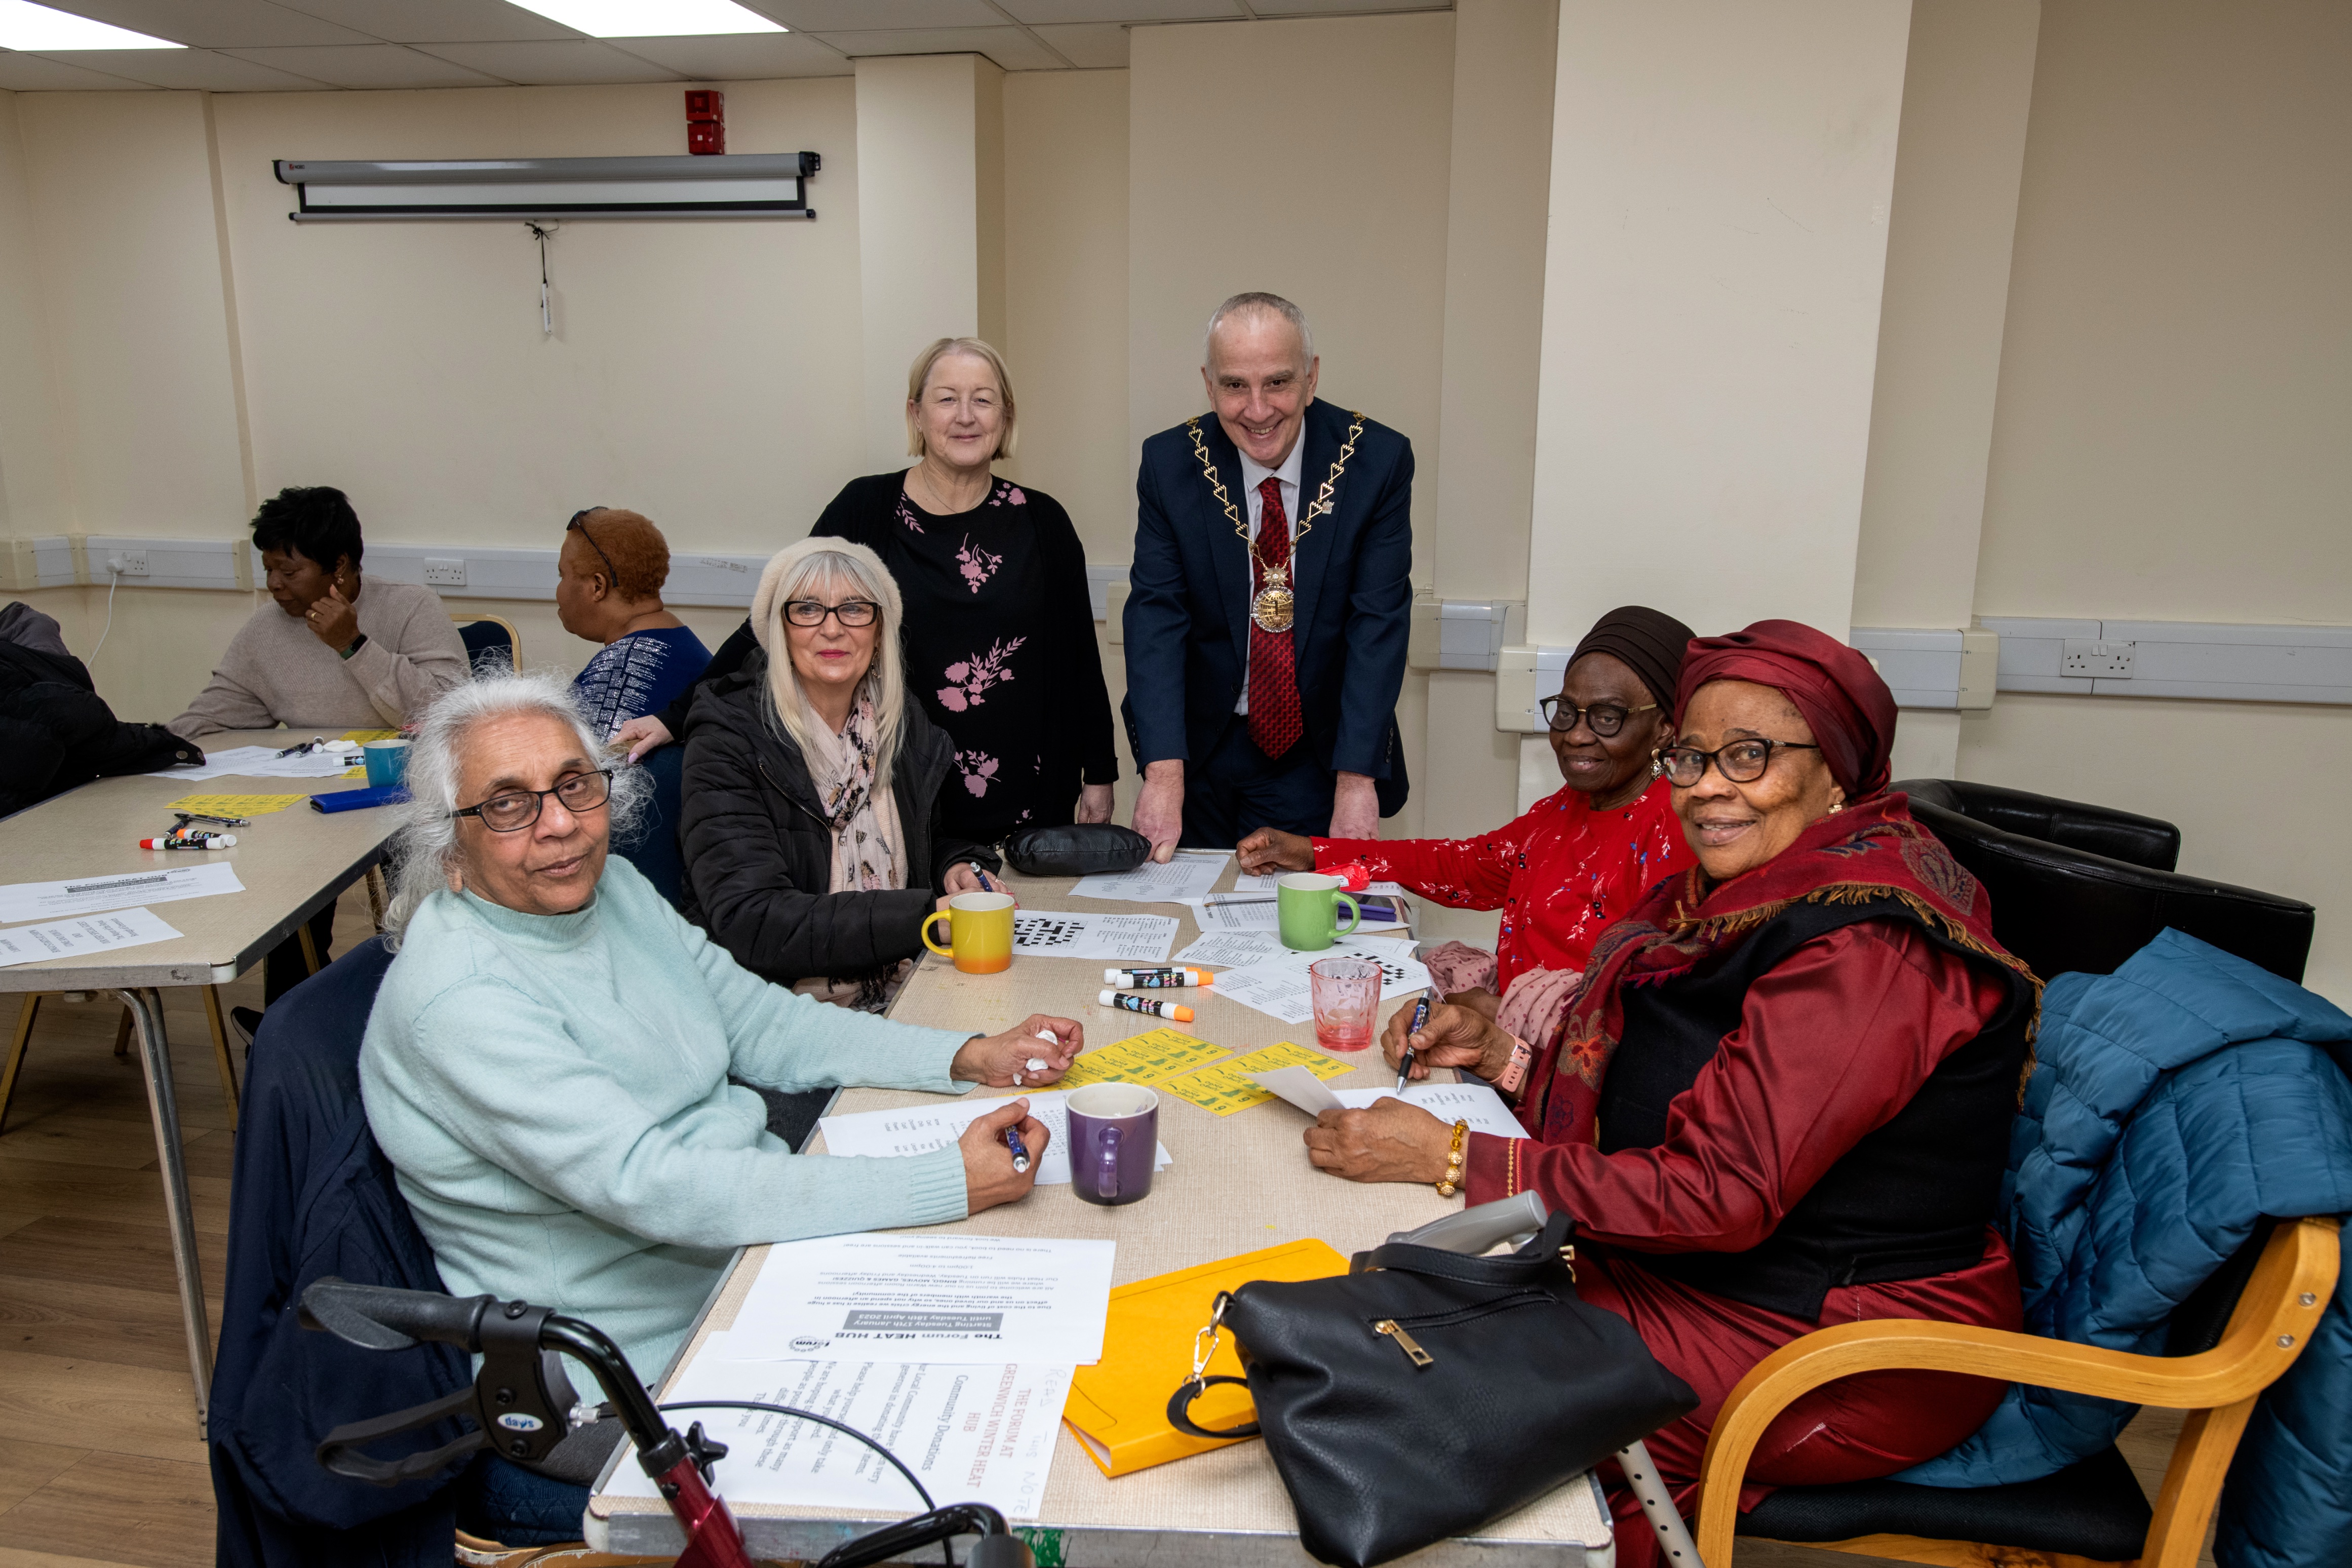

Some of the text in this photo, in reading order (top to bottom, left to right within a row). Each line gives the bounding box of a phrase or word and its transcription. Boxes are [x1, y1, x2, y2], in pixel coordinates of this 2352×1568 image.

[802, 1361, 819, 1382] people
[819, 1370, 830, 1381] are
[856, 1361, 874, 1382] Please
[918, 1363, 927, 1372] ur
[891, 1364, 910, 1393] generous
[910, 1373, 925, 1389] Local
[804, 1382, 827, 1404] hoping
[827, 1389, 841, 1405] what
[846, 1382, 864, 1397] help
[872, 1402, 895, 1432] donating
[891, 1390, 917, 1429] Community
[737, 1414, 751, 1427] you
[755, 1414, 773, 1434] times.
[921, 1375, 968, 1471] Community Donations
[963, 1413, 981, 1432] HUB
[967, 1363, 1017, 1487] GREENWICH WINTER HEAT
[999, 1388, 1031, 1458] THE FORUM AT
[766, 1419, 789, 1447] through
[885, 1429, 901, 1447] have
[1013, 1368, 1066, 1513] READ THIS NOTE
[782, 1442, 792, 1451] as
[817, 1440, 833, 1457] only
[754, 1448, 772, 1468] these
[769, 1452, 787, 1472] many
[810, 1458, 826, 1473] take
[855, 1453, 872, 1475] items.
[867, 1467, 883, 1484] very
